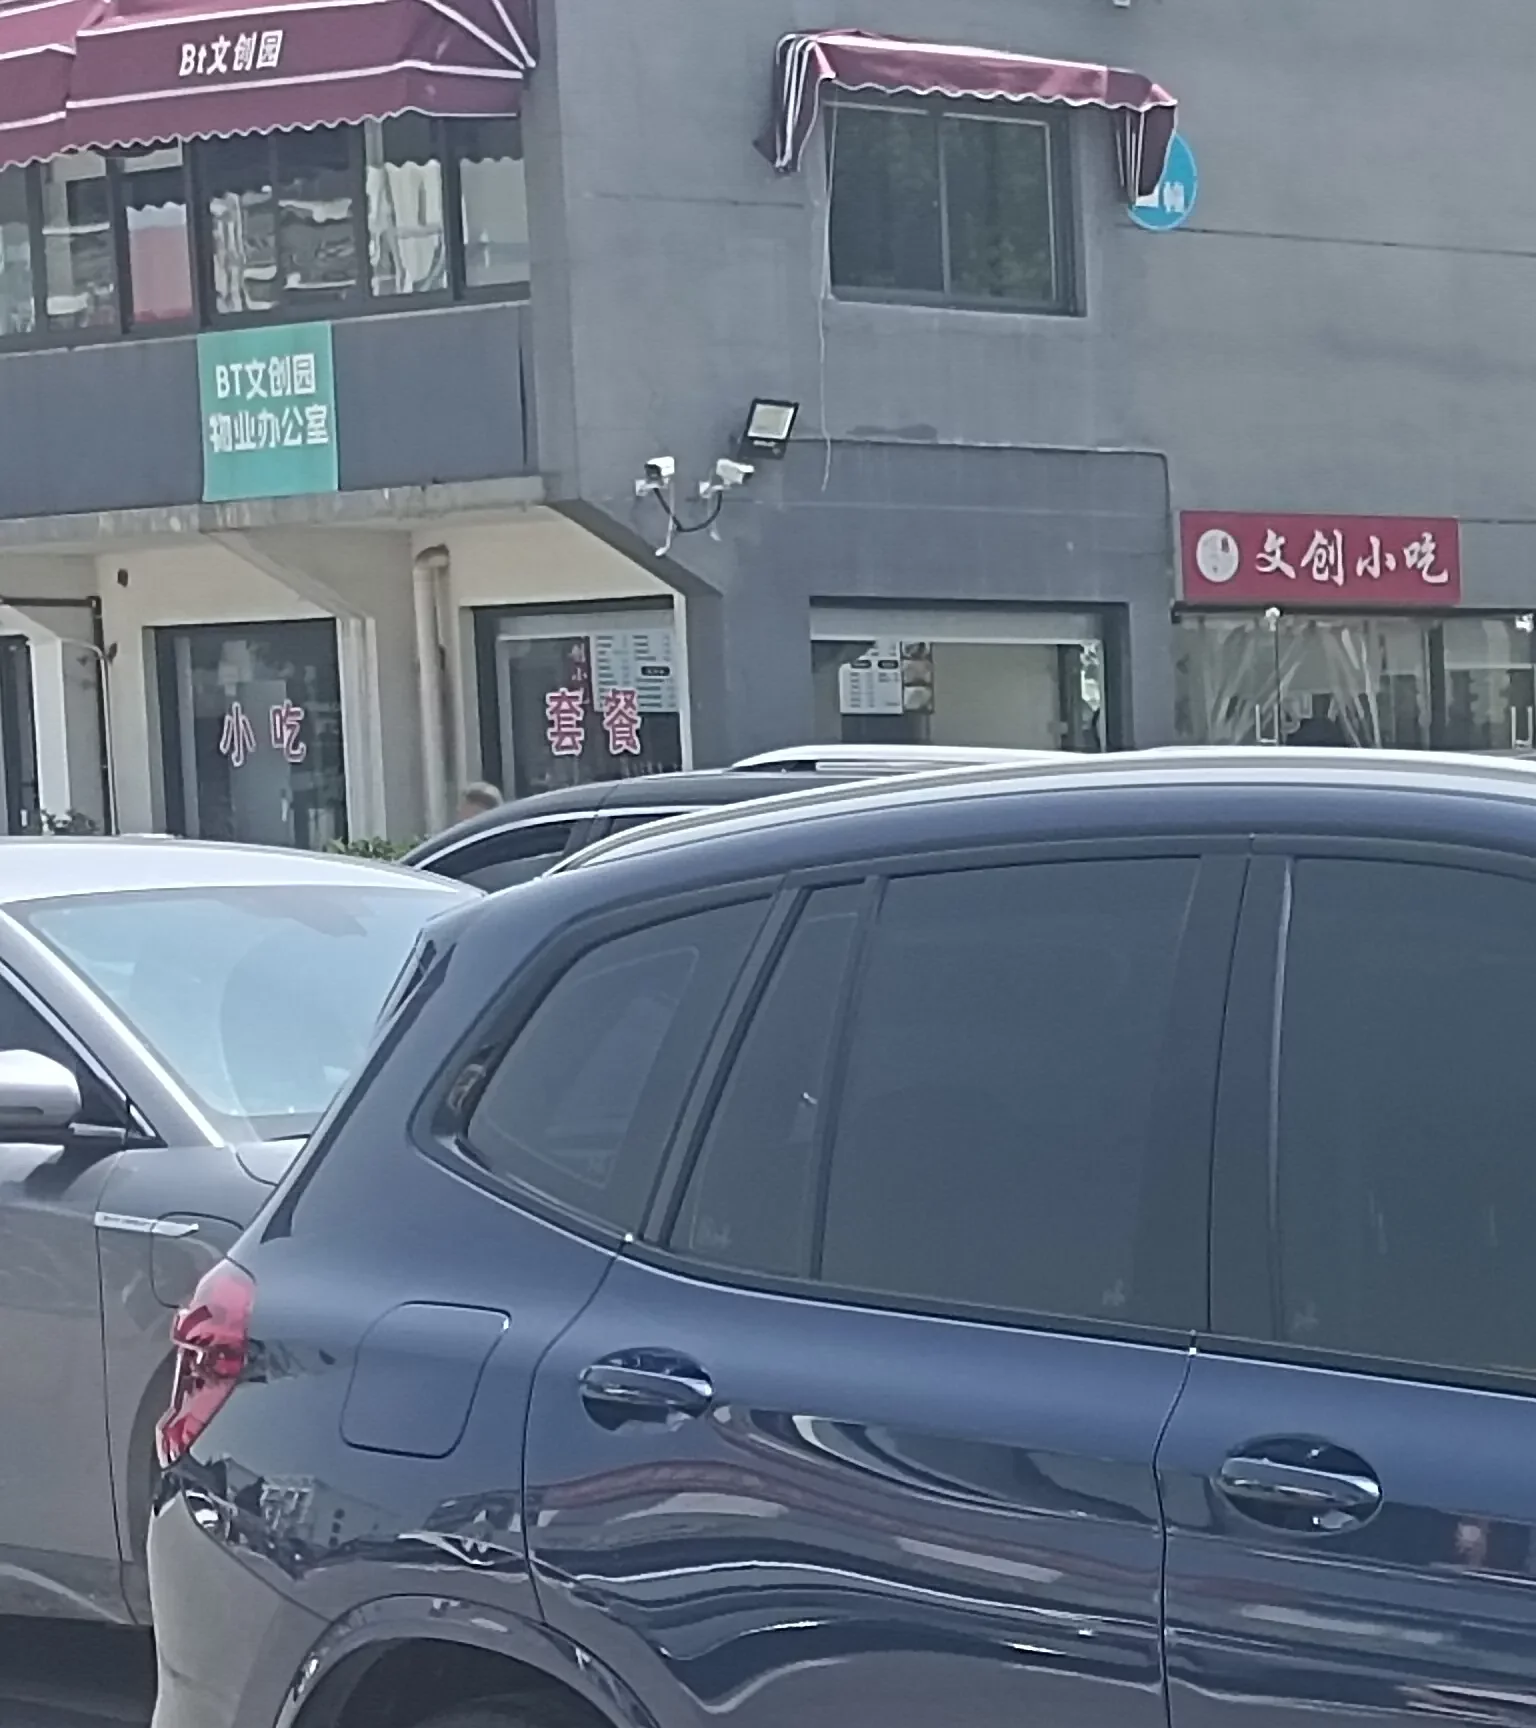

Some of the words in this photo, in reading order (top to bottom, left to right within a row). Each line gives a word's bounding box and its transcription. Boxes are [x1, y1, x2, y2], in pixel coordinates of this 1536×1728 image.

[178, 29, 283, 76] Bt文创园
[215, 353, 316, 400] BT文创园
[208, 403, 329, 453] 物业办公室
[1255, 528, 1449, 587] 文创小吃
[219, 700, 307, 767] 小吃
[546, 687, 642, 755] 套餐
